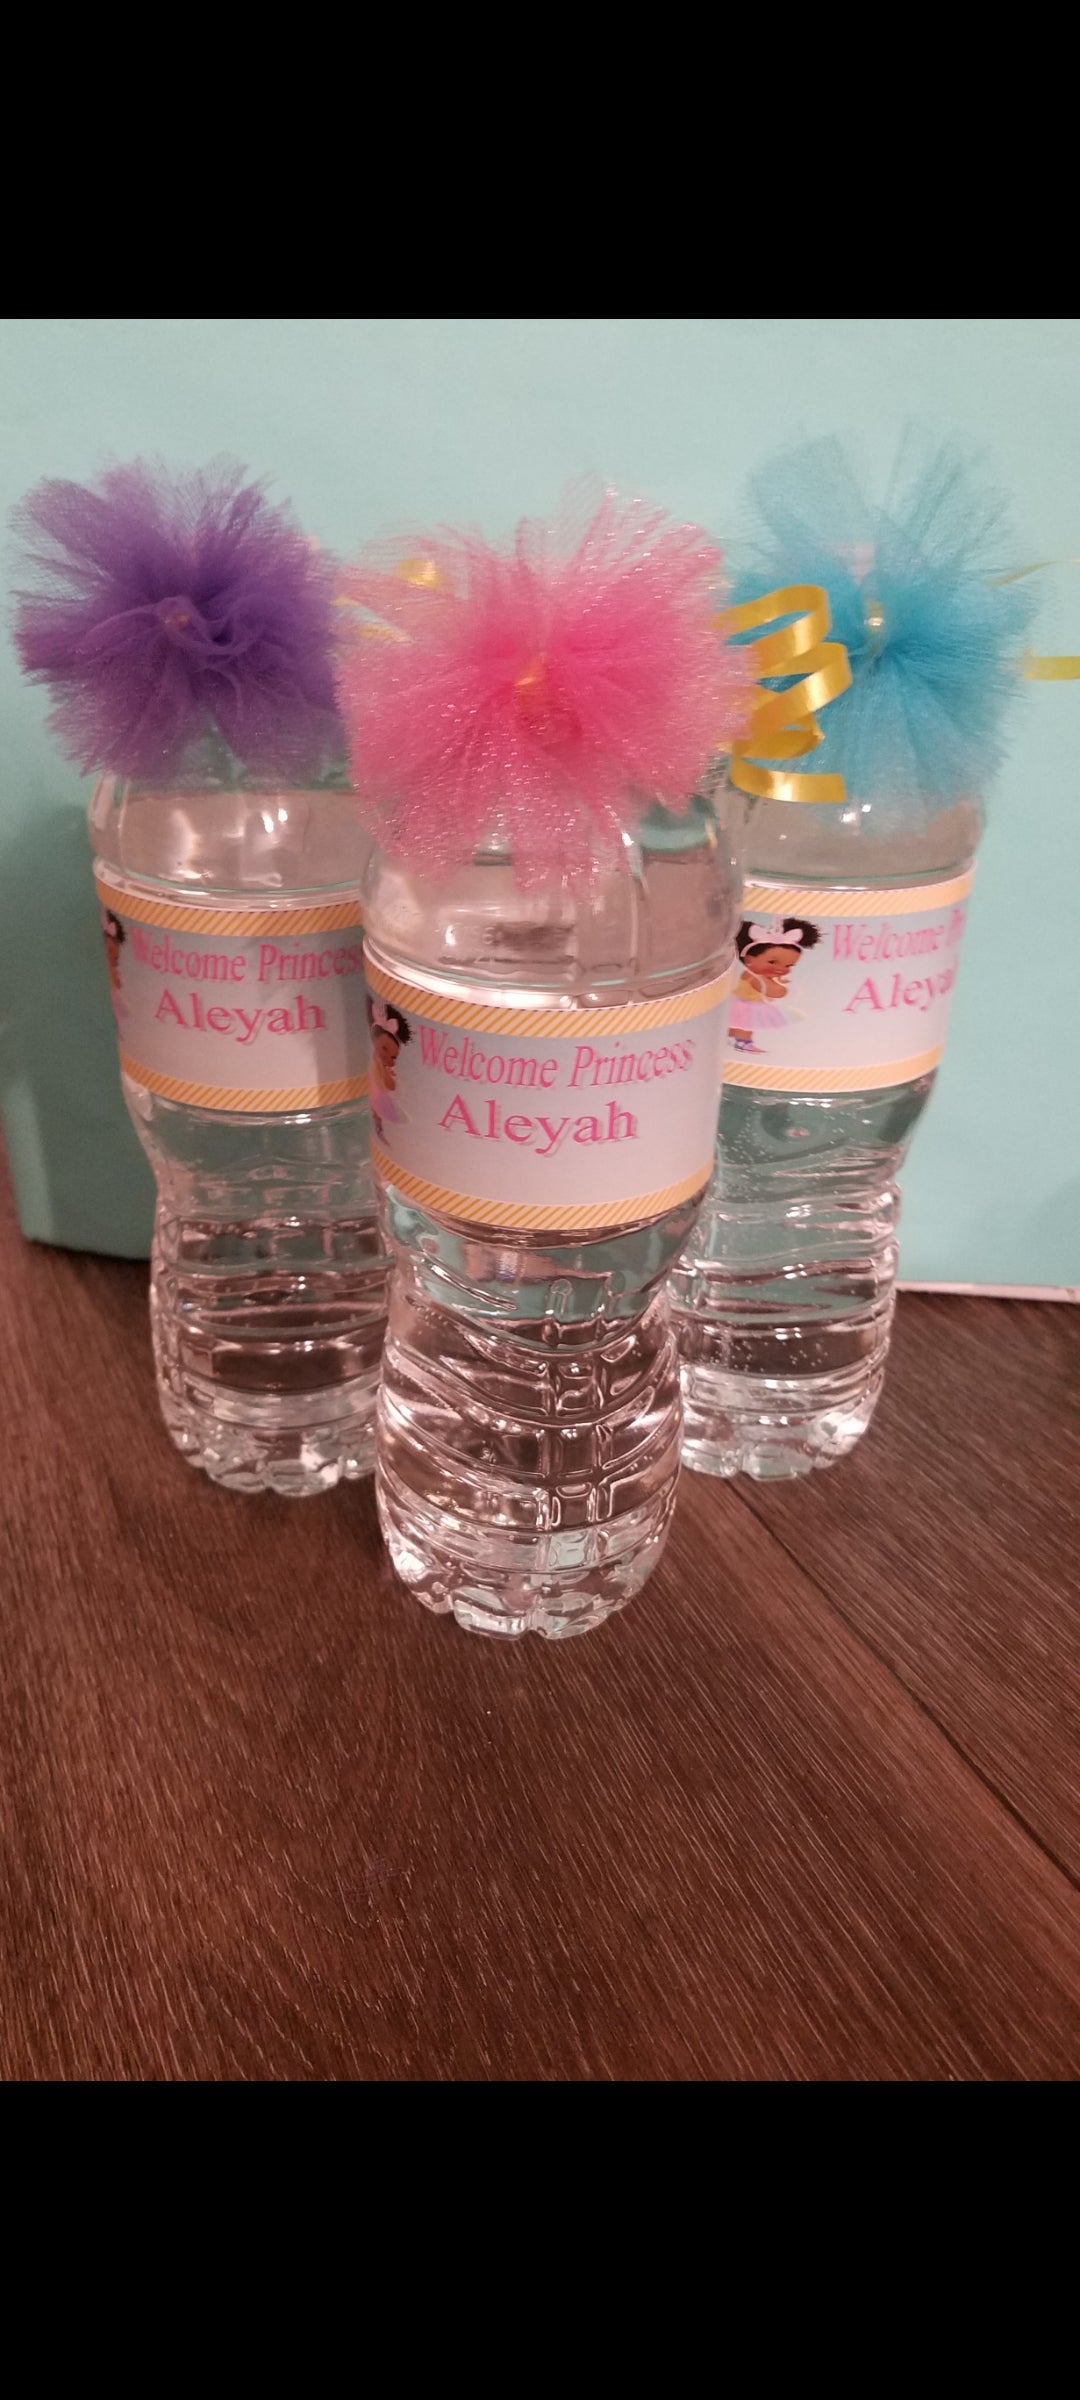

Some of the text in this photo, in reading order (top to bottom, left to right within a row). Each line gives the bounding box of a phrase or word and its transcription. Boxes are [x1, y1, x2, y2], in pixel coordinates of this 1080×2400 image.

[128, 925, 364, 983] Welcome Princes
[833, 922, 945, 961] Welcome
[154, 987, 326, 1044] Aleyah
[418, 1024, 696, 1088] Welcome Princess
[438, 1093, 638, 1156] Aleyah
